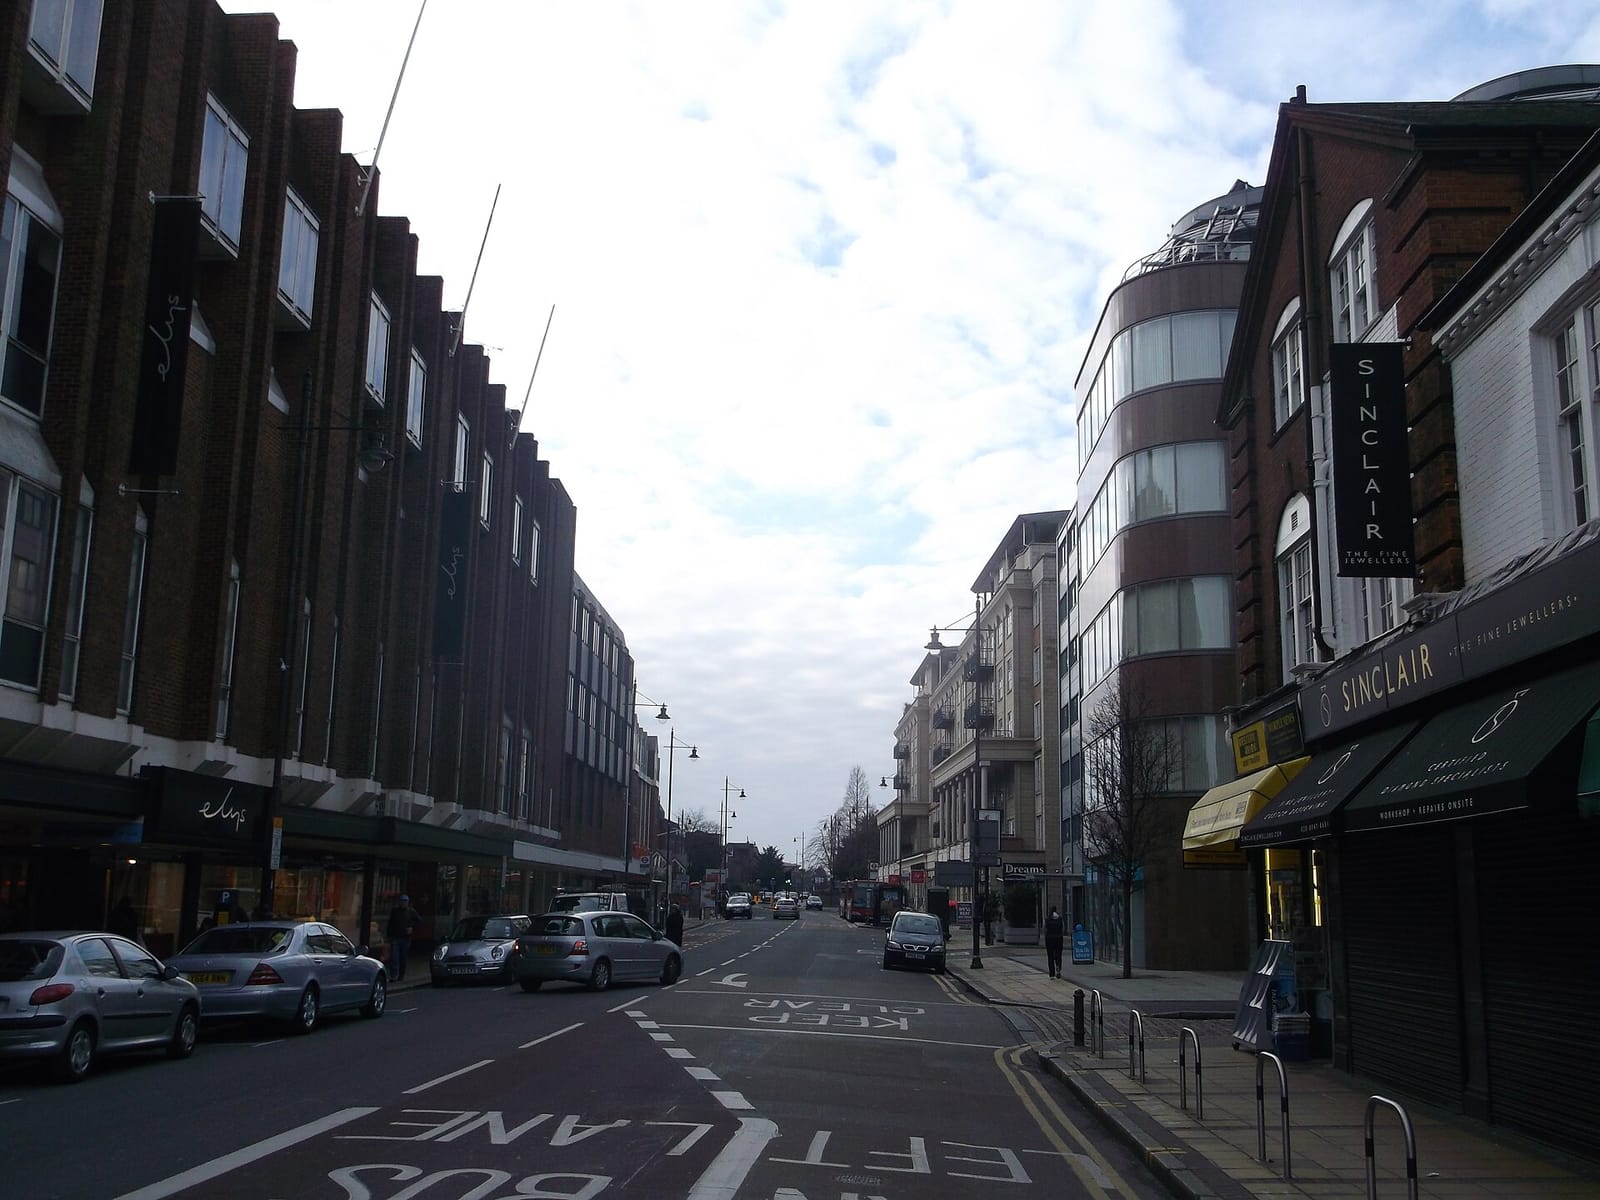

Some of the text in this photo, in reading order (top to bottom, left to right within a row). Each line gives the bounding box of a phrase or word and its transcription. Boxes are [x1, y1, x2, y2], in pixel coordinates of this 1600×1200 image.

[149, 294, 187, 383] elys
[1357, 359, 1384, 540] SINCLAIR
[441, 545, 464, 601] elys
[1345, 557, 1410, 565] JEWELLERS
[1346, 550, 1408, 558] THE FINE
[1341, 595, 1573, 713] SINCLAIR THE FINE JEWELLERS
[198, 786, 248, 832] elys
[1379, 797, 1474, 821] WORKSHOP REPAIRS ONSITE
[1005, 864, 1046, 874] Dreams
[743, 998, 925, 1015] CLEAR
[748, 1012, 909, 1031] KEEP
[331, 1109, 715, 1156] LANE
[768, 1129, 1117, 1190] LEFT
